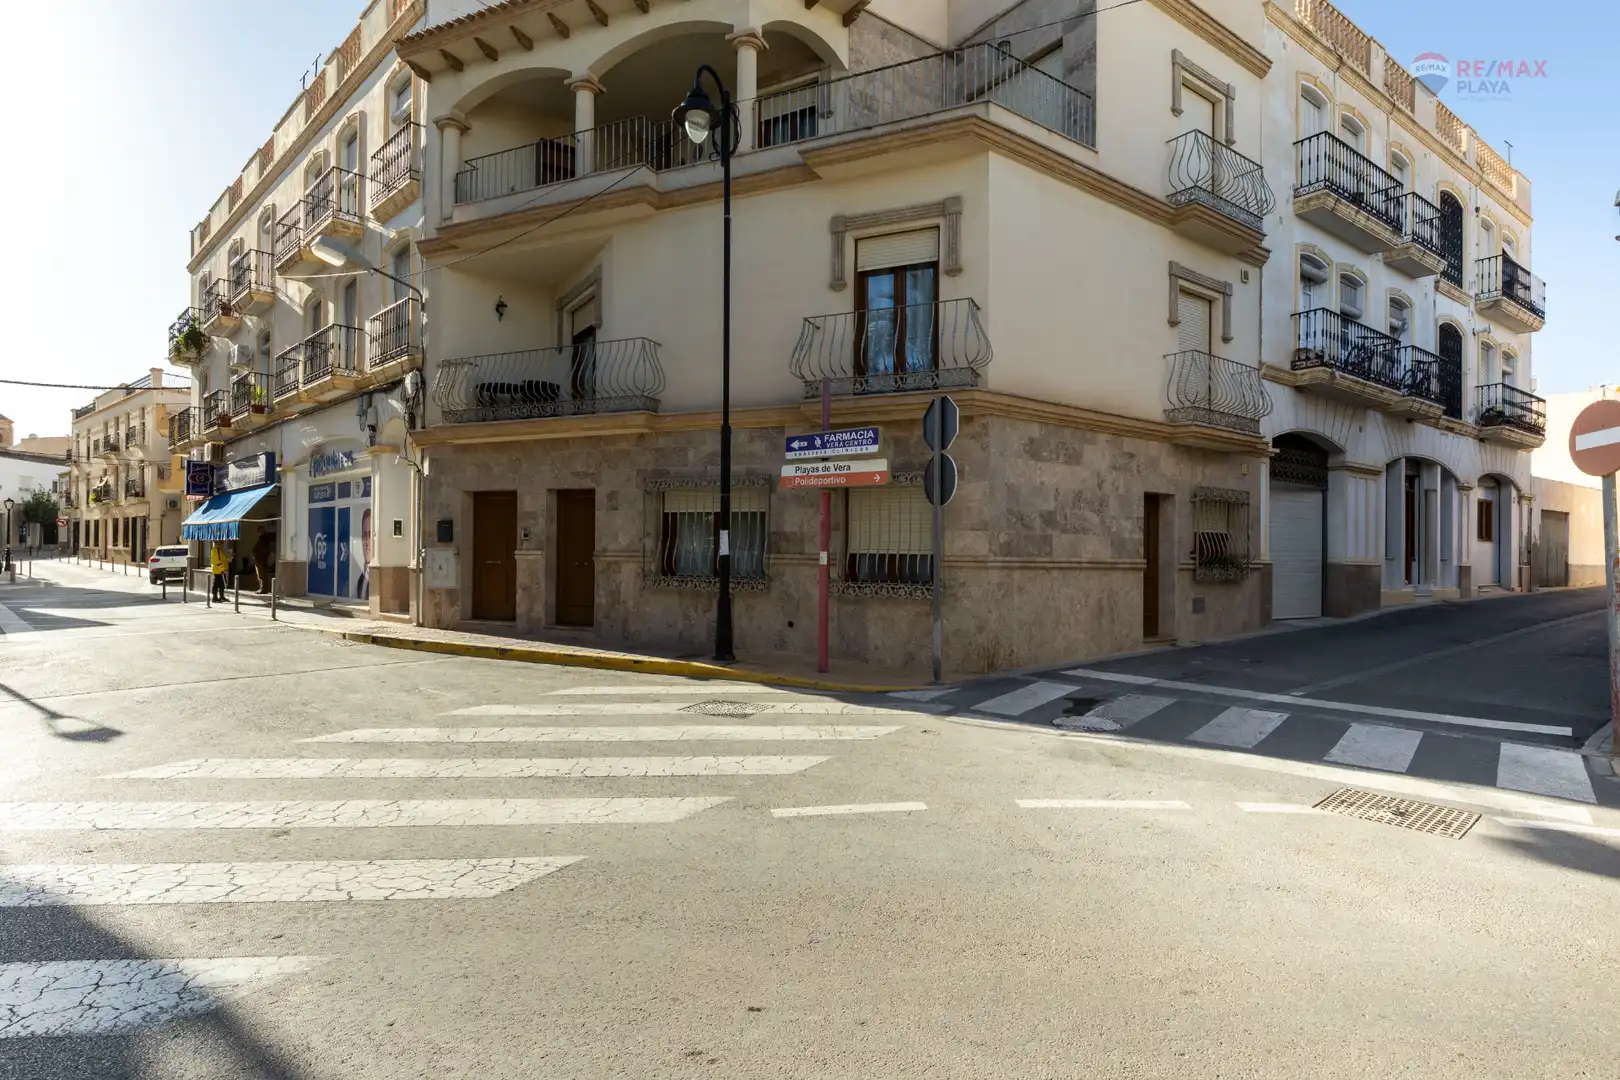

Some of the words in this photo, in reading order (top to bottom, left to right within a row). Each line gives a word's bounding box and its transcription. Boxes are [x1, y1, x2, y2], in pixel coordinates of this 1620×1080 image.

[824, 430, 874, 442] FARMACIA
[826, 441, 844, 449] VERA
[845, 438, 873, 447] CENTRO
[795, 465, 820, 475] Playas
[833, 463, 851, 472] Vera
[795, 476, 846, 487] Polideportivo
